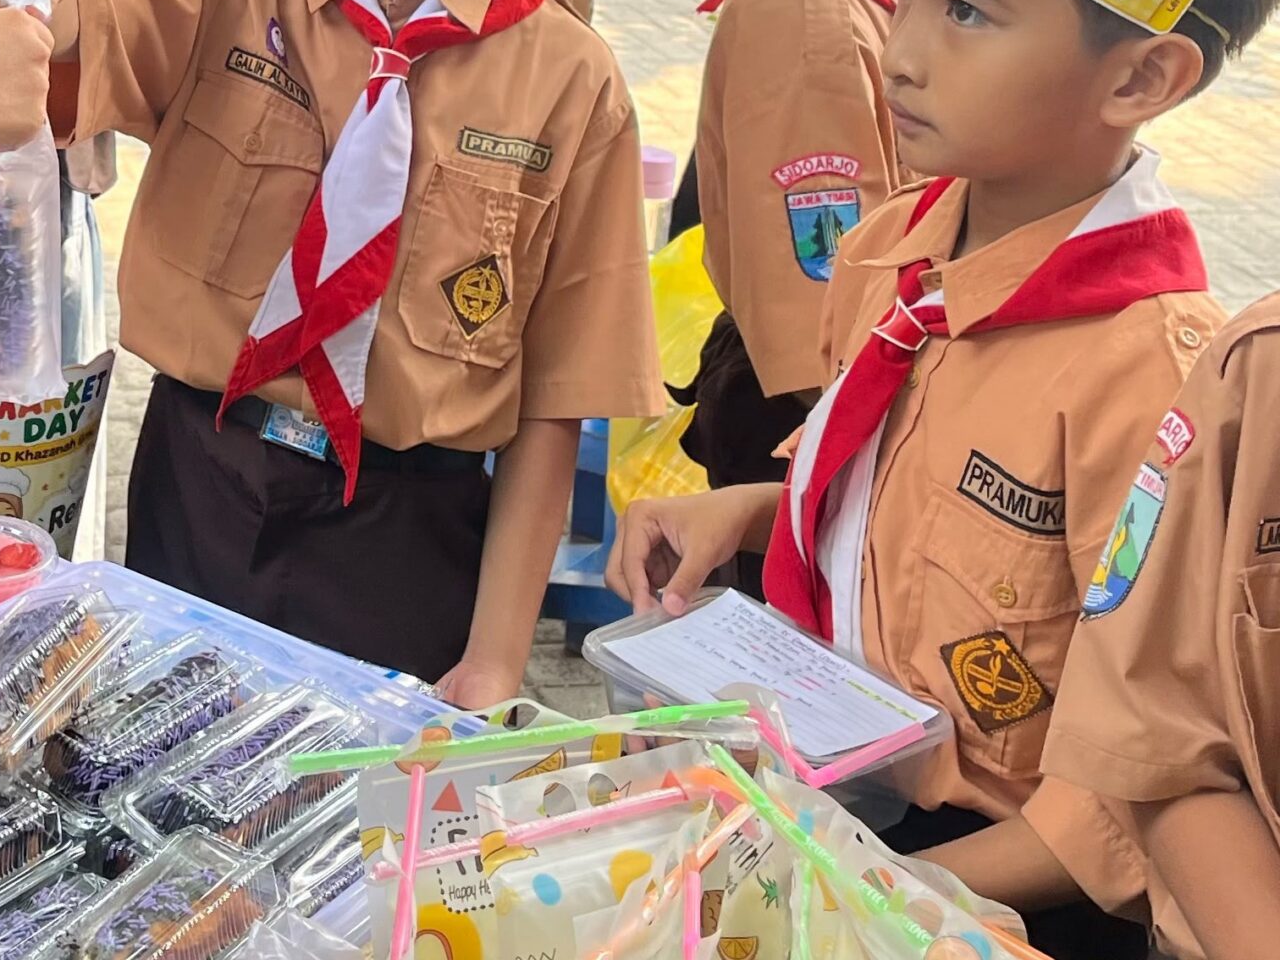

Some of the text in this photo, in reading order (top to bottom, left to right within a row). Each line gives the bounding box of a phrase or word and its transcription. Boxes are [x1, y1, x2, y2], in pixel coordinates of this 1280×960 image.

[235, 53, 266, 76] GALIH
[778, 157, 854, 182] SIDOARJO
[24, 406, 85, 443] DAY
[448, 884, 477, 902] Happy
